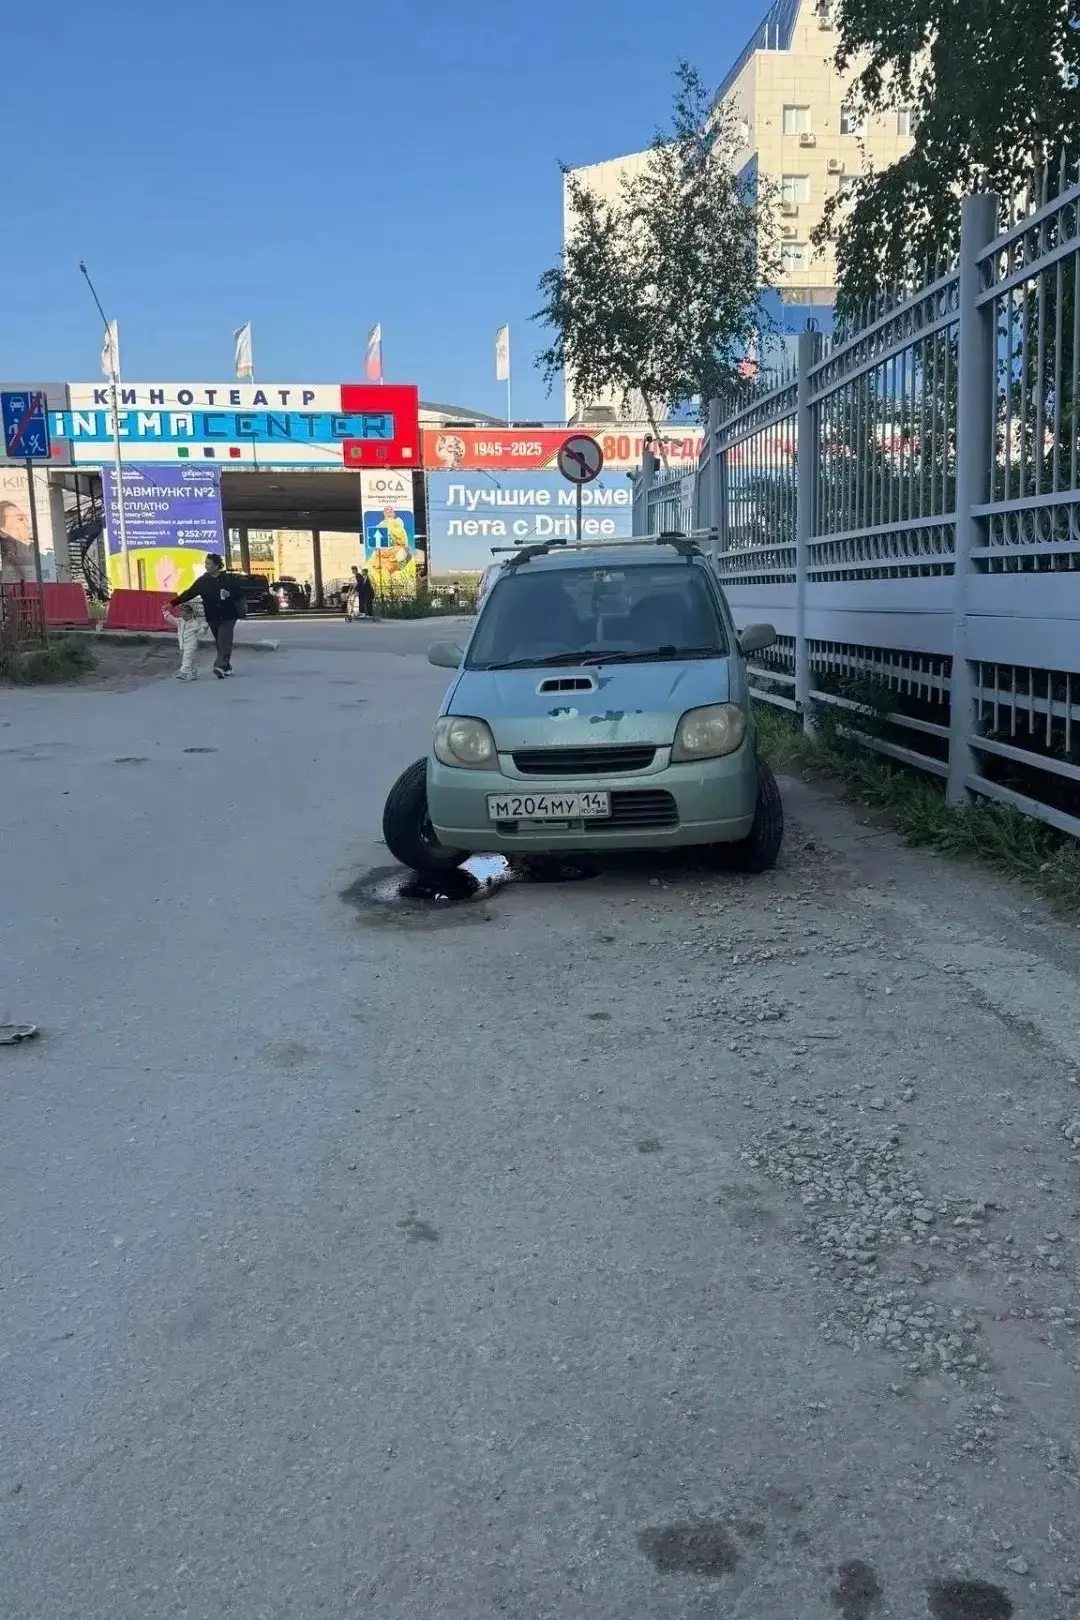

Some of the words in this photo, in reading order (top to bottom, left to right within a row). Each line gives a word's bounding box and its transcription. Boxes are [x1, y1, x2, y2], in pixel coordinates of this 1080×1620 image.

[93, 388, 316, 406] КИНОТЕАТР
[601, 434, 631, 461] 80
[369, 479, 405, 491] LOCA
[110, 501, 170, 511] БСПЛАТНО
[446, 484, 551, 511] Лучшие
[447, 518, 507, 536] лета
[535, 513, 616, 536] Drivee
[184, 530, 217, 538] 252-777
